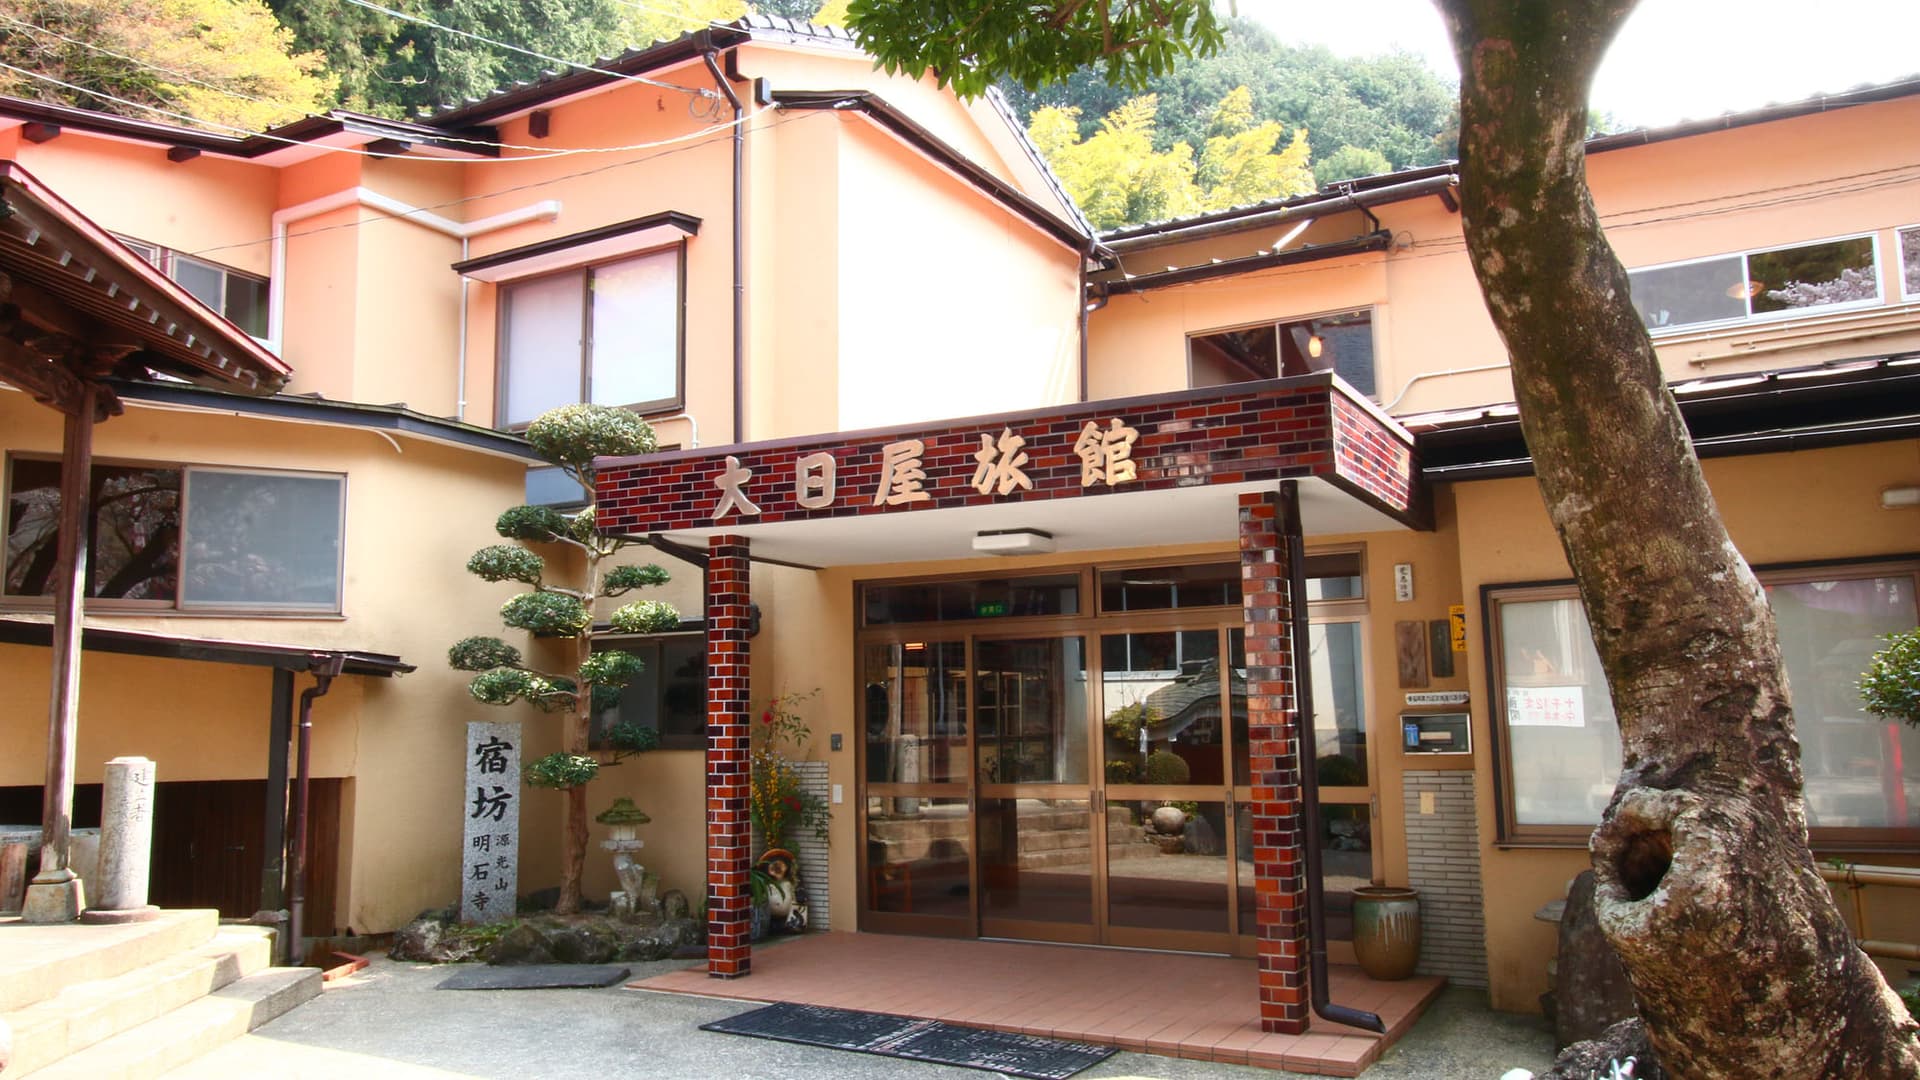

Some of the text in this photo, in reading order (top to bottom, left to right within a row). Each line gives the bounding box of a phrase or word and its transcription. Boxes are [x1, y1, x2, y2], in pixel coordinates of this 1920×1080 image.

[713, 418, 1139, 520] 大日屋旅館
[472, 736, 513, 822] 宿坊
[469, 833, 492, 913] 明石寺
[494, 833, 512, 892] 源光山
